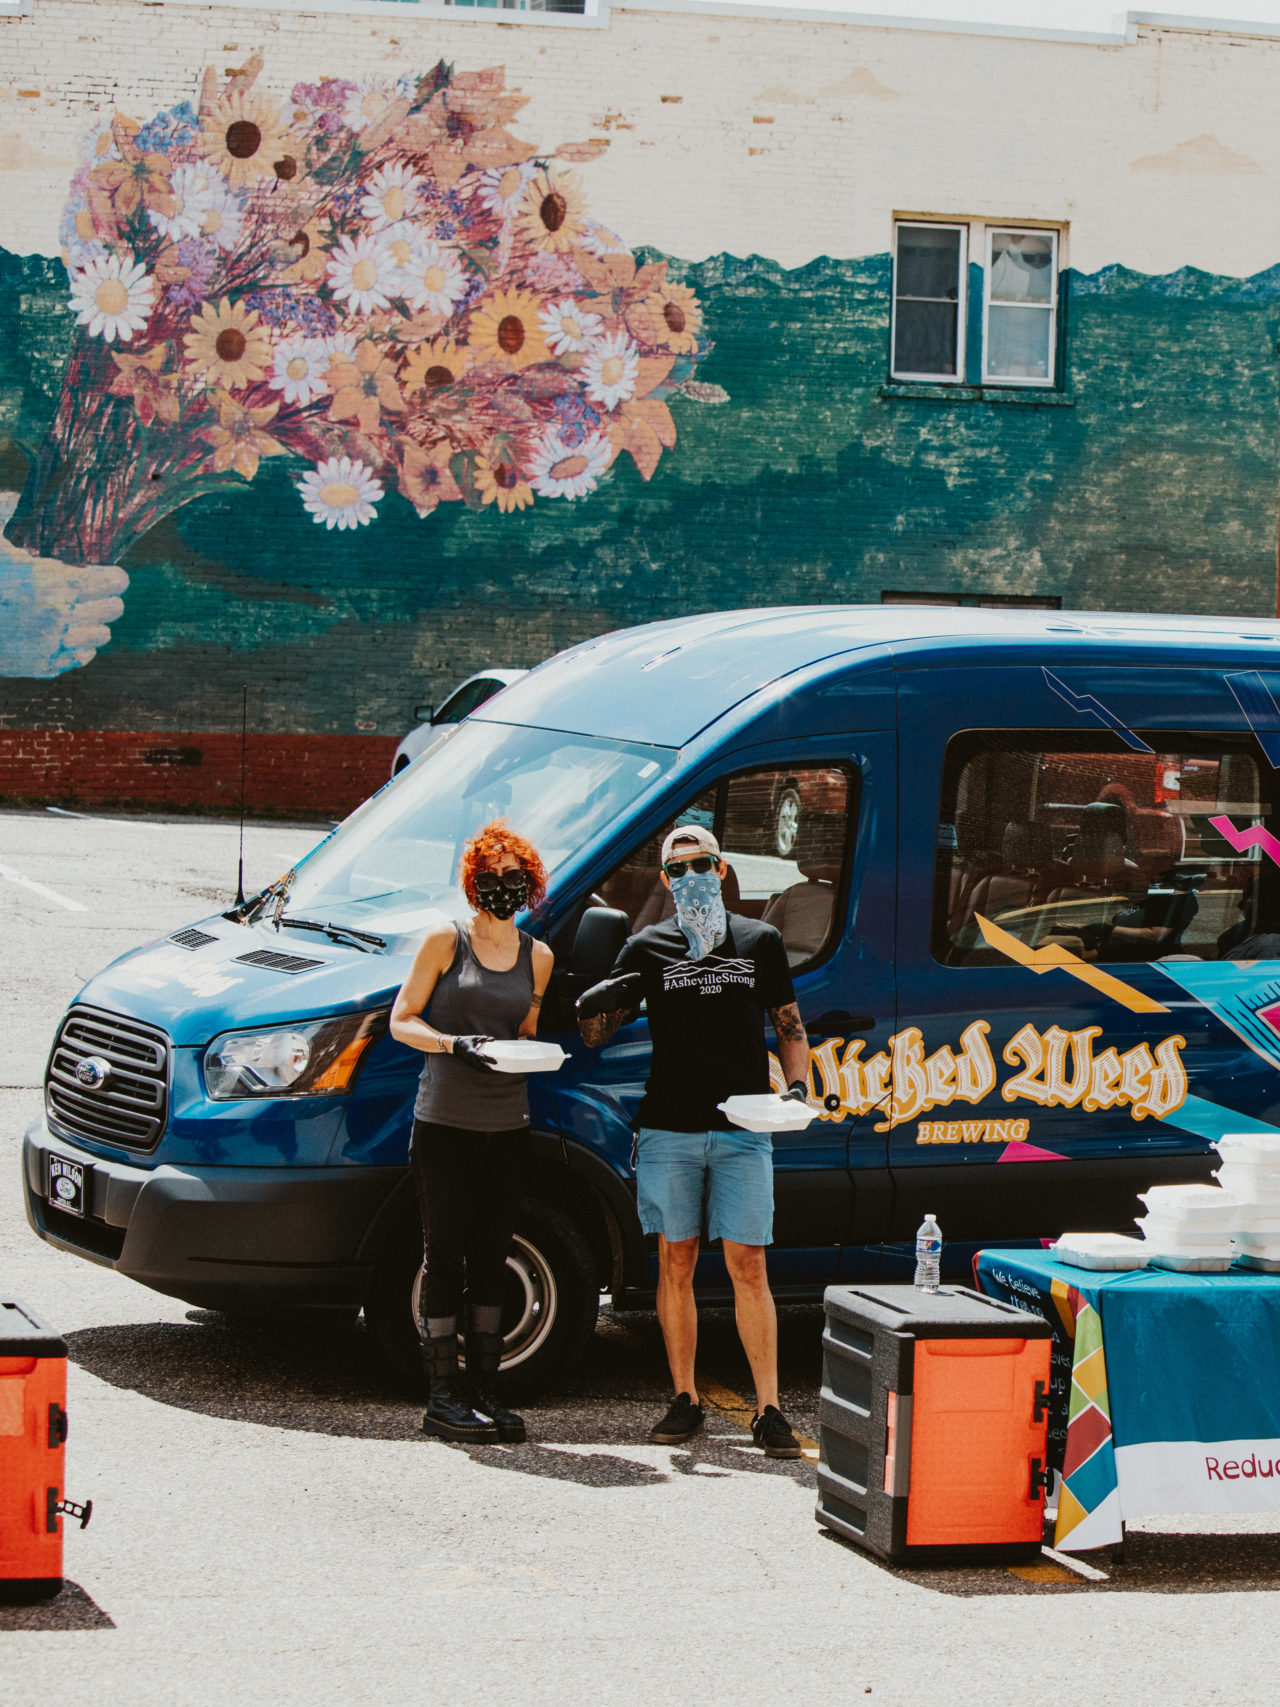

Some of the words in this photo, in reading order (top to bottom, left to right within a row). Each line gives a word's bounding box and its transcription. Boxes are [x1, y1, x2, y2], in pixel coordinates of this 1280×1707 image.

[663, 972, 756, 992] #AshevilleStrong
[699, 984, 722, 995] 2020
[1002, 1022, 1189, 1122] Weed
[916, 1119, 1029, 1144] BREWING
[992, 1268, 1009, 1287] We
